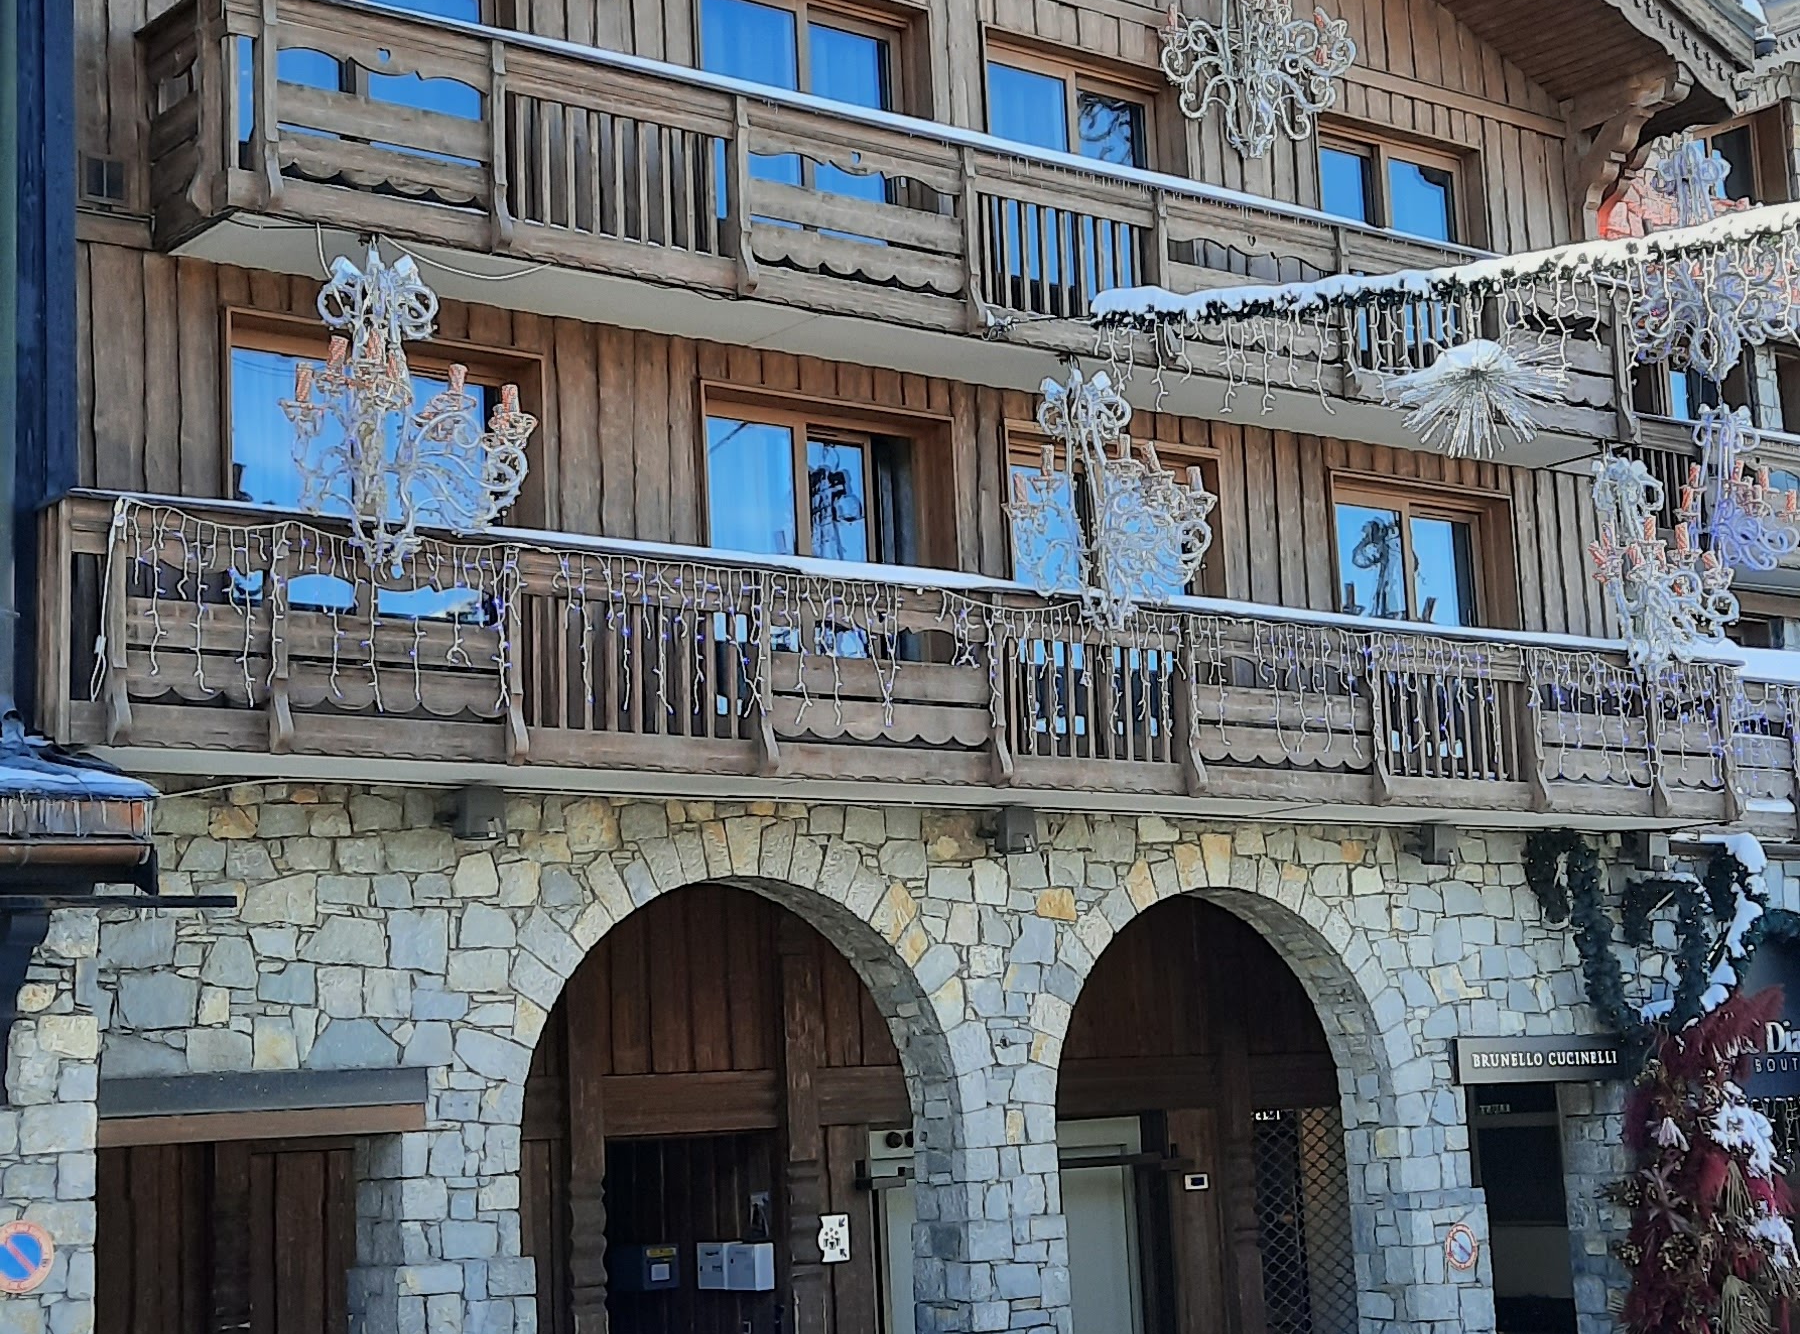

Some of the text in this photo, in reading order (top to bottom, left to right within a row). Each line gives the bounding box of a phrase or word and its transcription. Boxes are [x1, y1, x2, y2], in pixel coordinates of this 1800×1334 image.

[1472, 1050, 1617, 1068] BRUNELLO CUCINELLI
[1754, 1057, 1798, 1073] BOUT
